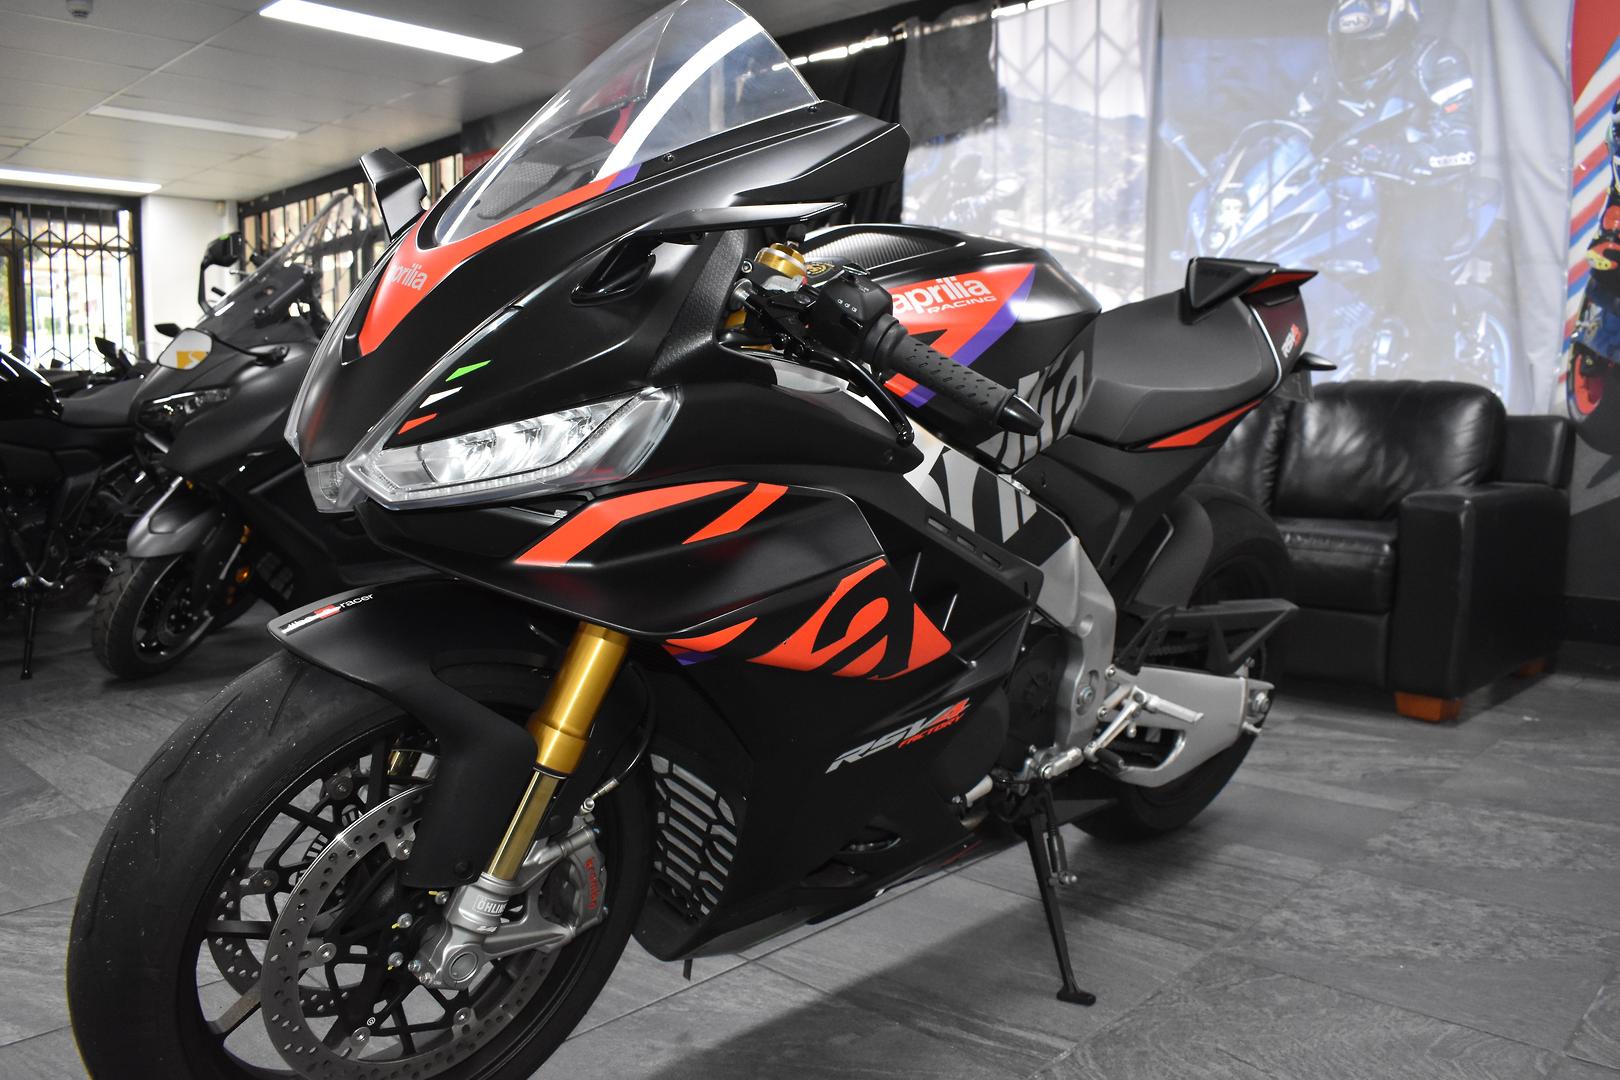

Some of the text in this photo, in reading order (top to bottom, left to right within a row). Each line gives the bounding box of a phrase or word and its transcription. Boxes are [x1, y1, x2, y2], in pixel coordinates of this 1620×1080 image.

[387, 263, 428, 291] prilia
[892, 276, 992, 315] aprilia
[926, 295, 998, 315] RACING
[340, 593, 374, 609] racer
[825, 697, 971, 774] RSV4
[476, 895, 508, 914] ÖHLIN
